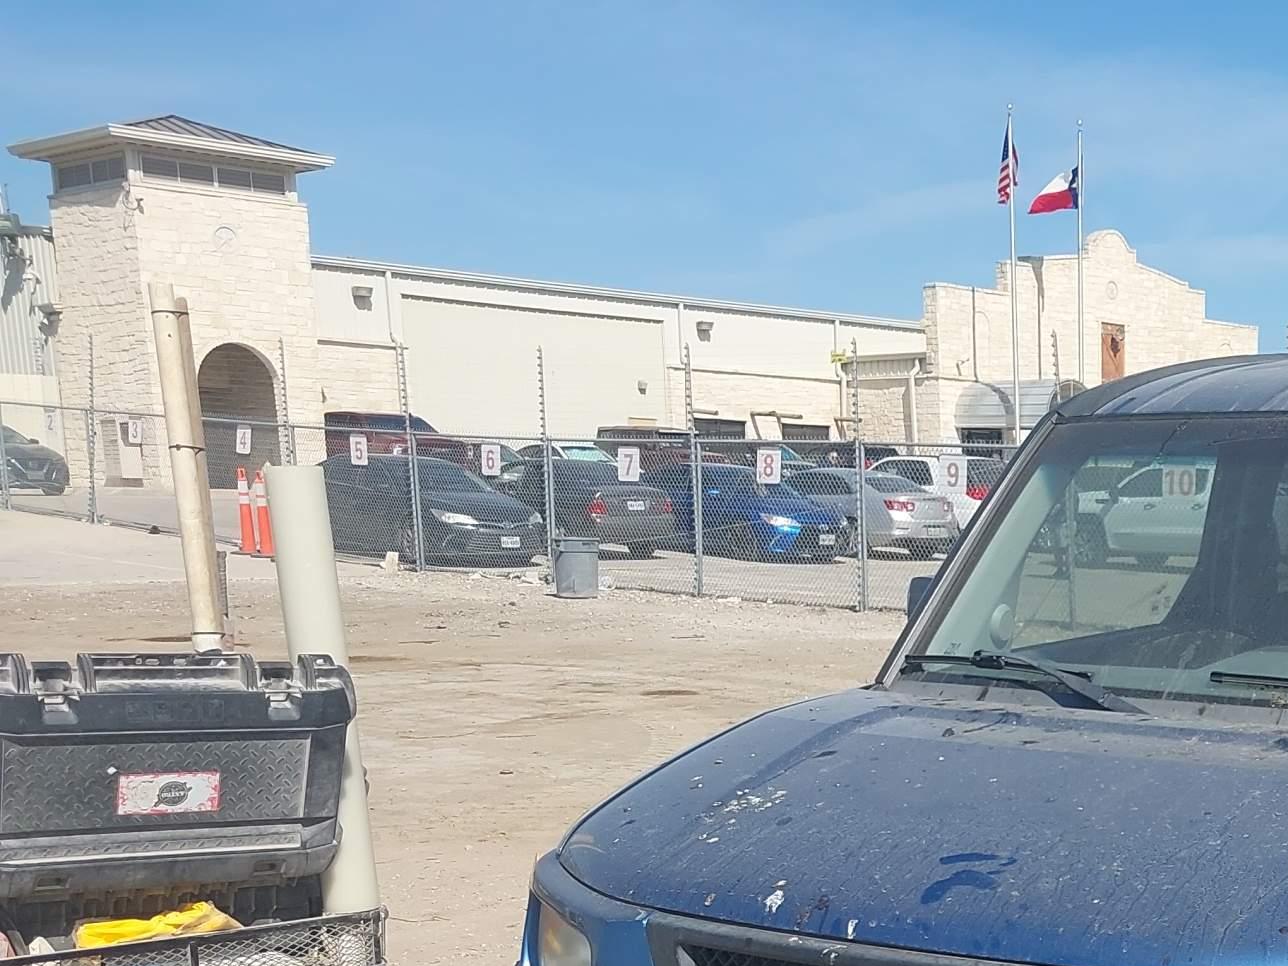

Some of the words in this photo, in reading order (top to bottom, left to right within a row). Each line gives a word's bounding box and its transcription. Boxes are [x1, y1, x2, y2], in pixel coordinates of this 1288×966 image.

[131, 422, 138, 438] 3
[240, 432, 247, 449] 4
[355, 441, 363, 460] 5
[486, 450, 495, 469] 6
[624, 454, 634, 475] 7
[763, 455, 774, 477] 8
[947, 463, 959, 487] 9
[1166, 471, 1194, 496] 10
